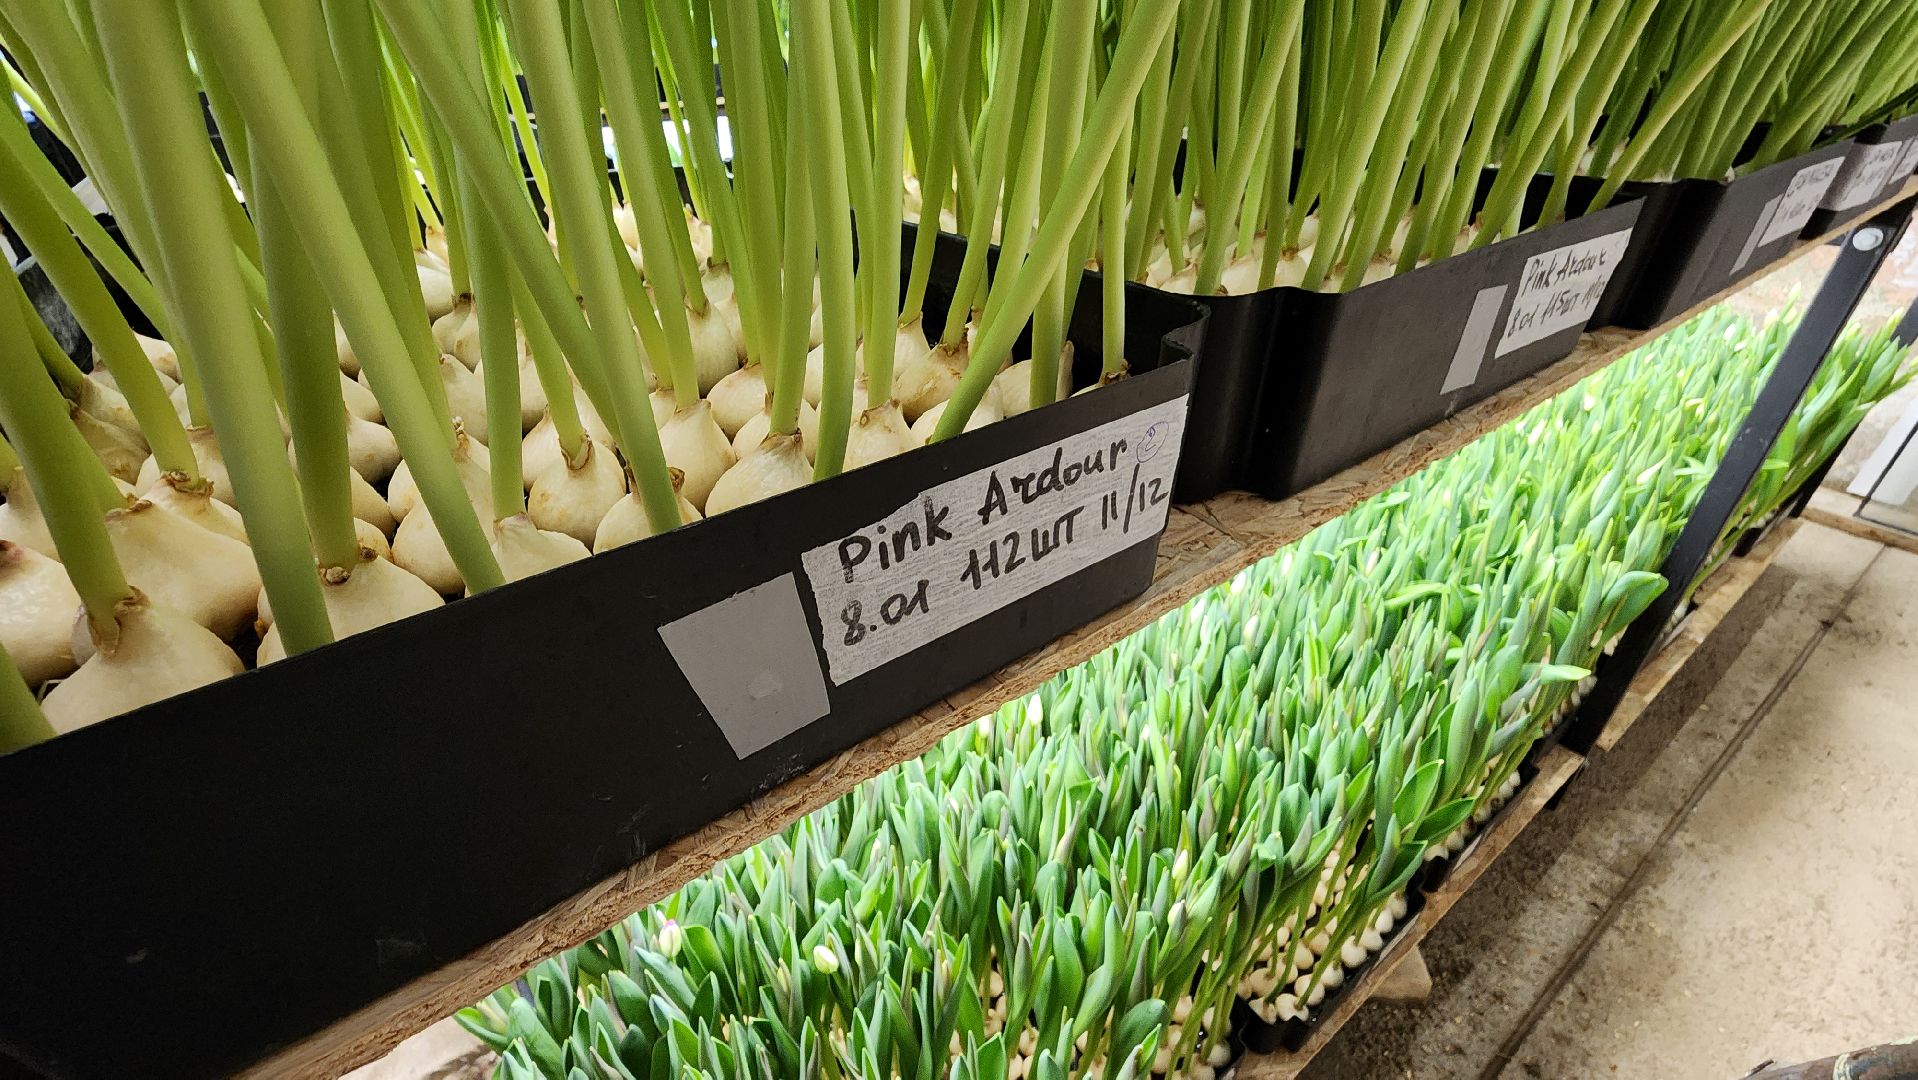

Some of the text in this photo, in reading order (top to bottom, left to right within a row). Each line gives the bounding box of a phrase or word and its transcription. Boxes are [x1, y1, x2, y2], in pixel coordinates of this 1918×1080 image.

[1521, 253, 1558, 298] Pink
[838, 496, 952, 583] Pink
[978, 438, 1128, 525] Ardour
[840, 579, 930, 646] 8.01
[1102, 463, 1169, 534] 11/12
